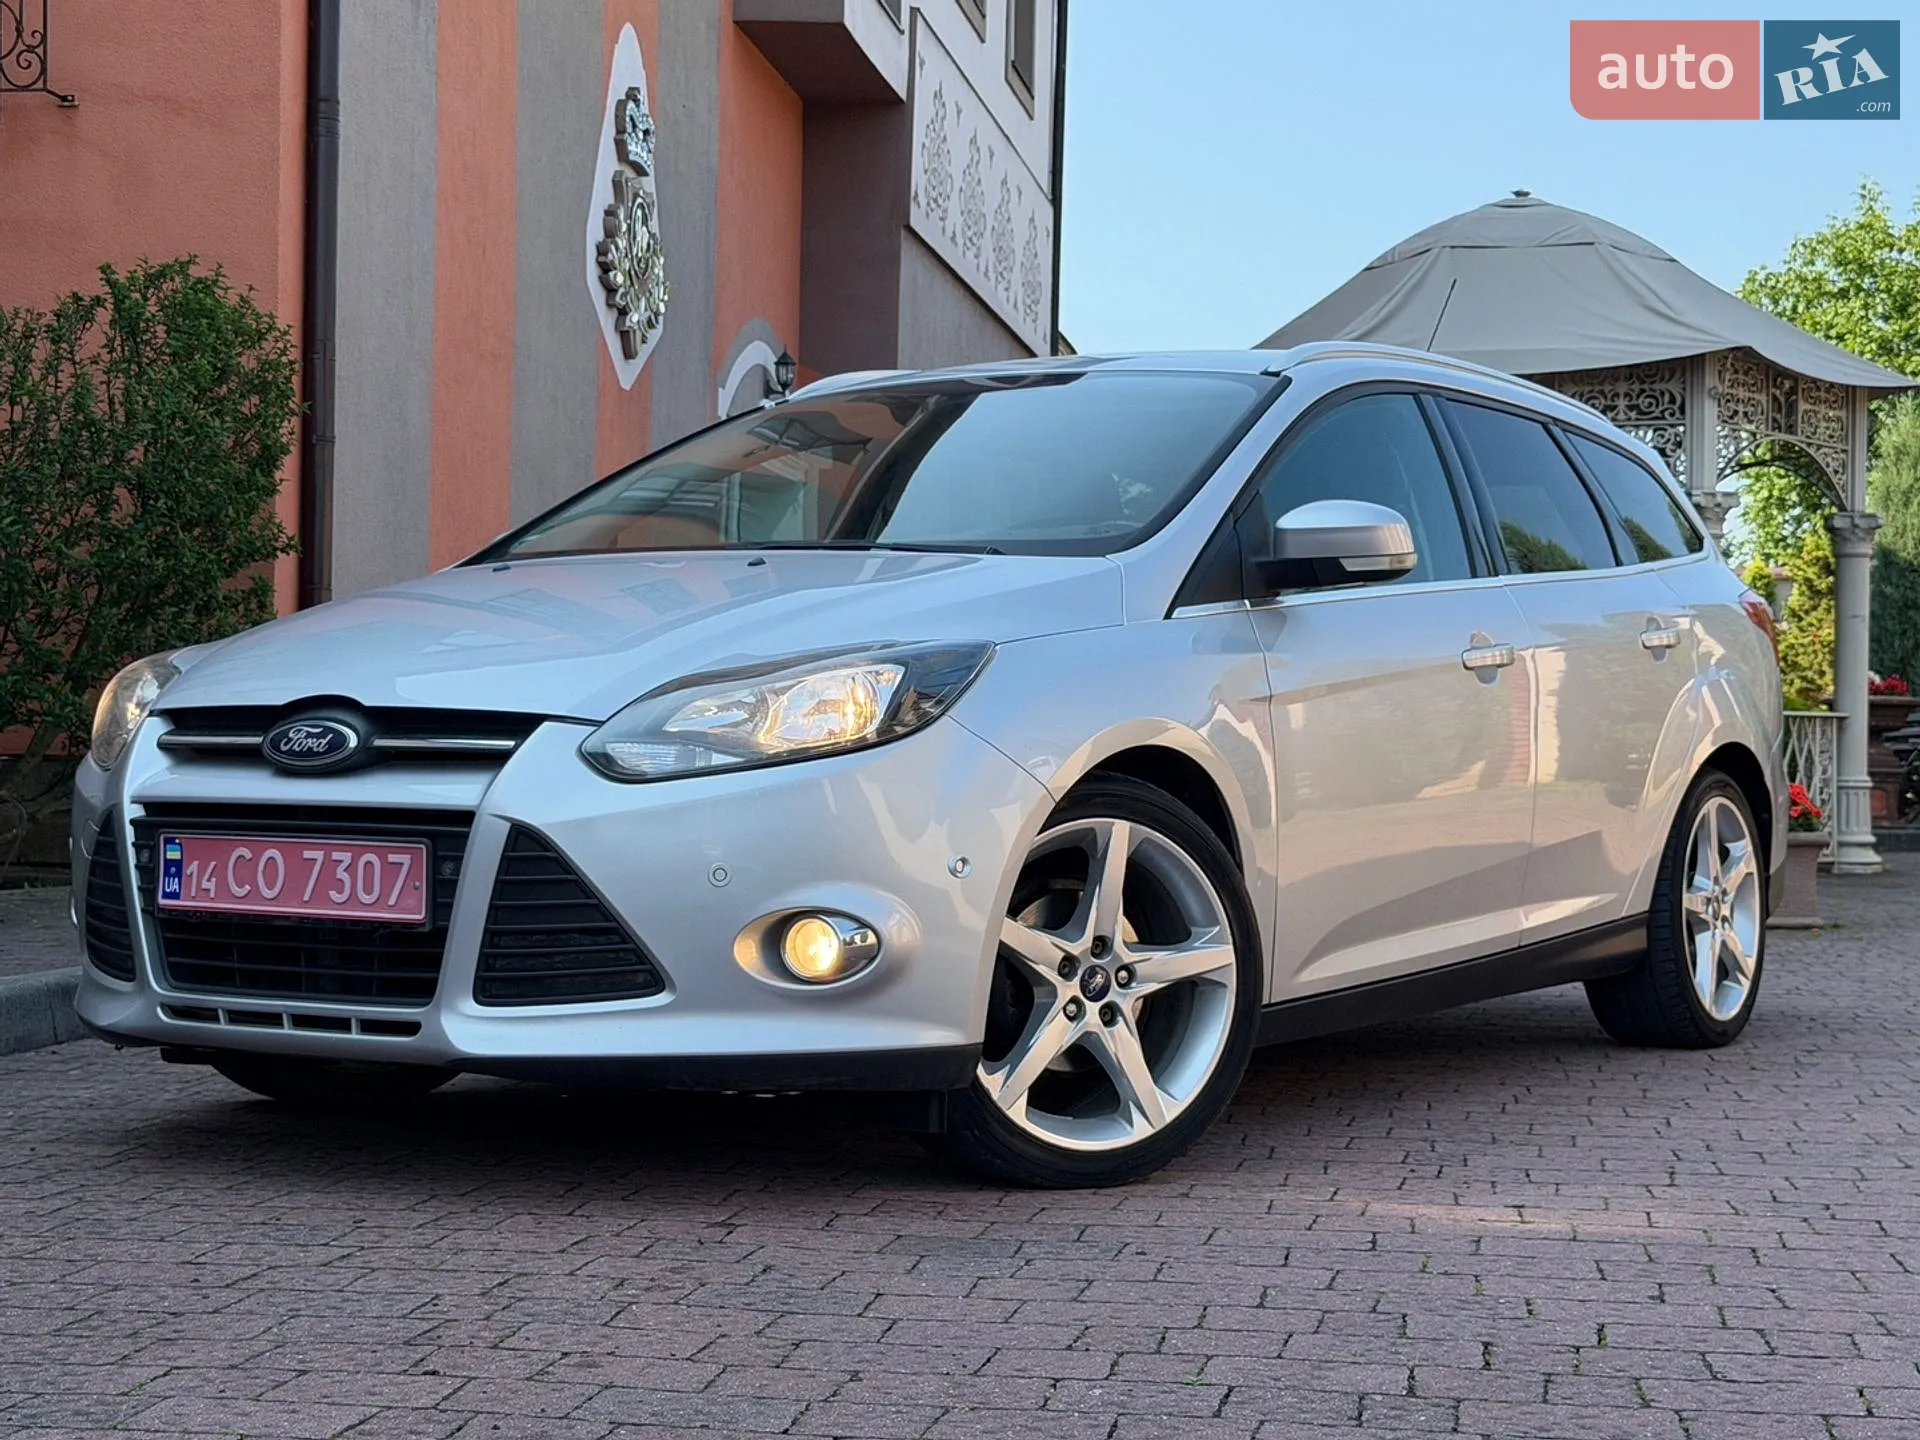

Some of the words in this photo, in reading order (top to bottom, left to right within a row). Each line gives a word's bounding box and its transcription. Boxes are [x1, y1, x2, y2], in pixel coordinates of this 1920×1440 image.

[280, 726, 334, 753] Ford
[165, 876, 180, 893] UA
[186, 860, 217, 899] 14
[227, 847, 286, 900] CO
[302, 850, 412, 907] 7307
